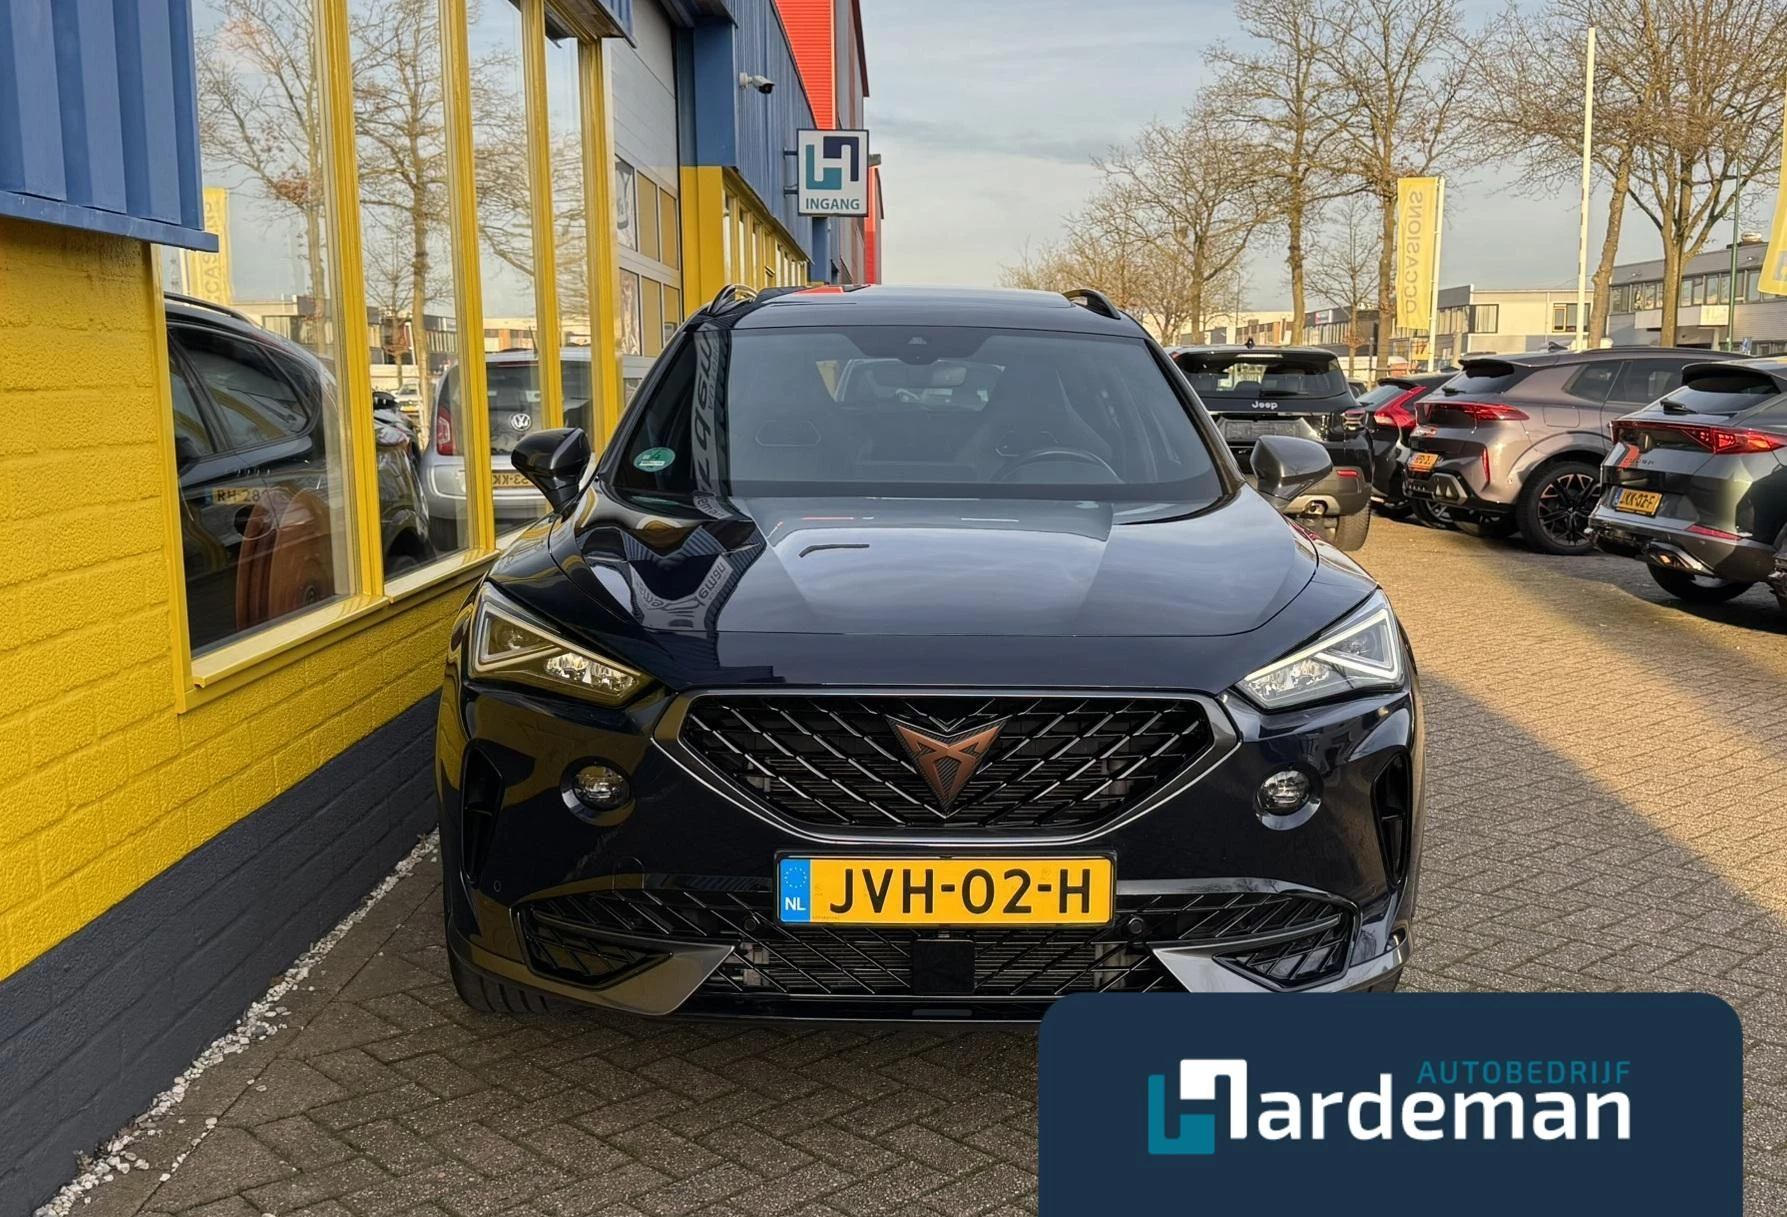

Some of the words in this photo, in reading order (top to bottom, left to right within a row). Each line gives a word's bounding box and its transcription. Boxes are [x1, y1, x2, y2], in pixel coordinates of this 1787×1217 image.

[806, 198, 860, 210] INGANG
[1252, 401, 1278, 410] Jeep
[785, 897, 806, 911] NL
[829, 868, 1091, 914] JVH-02-H
